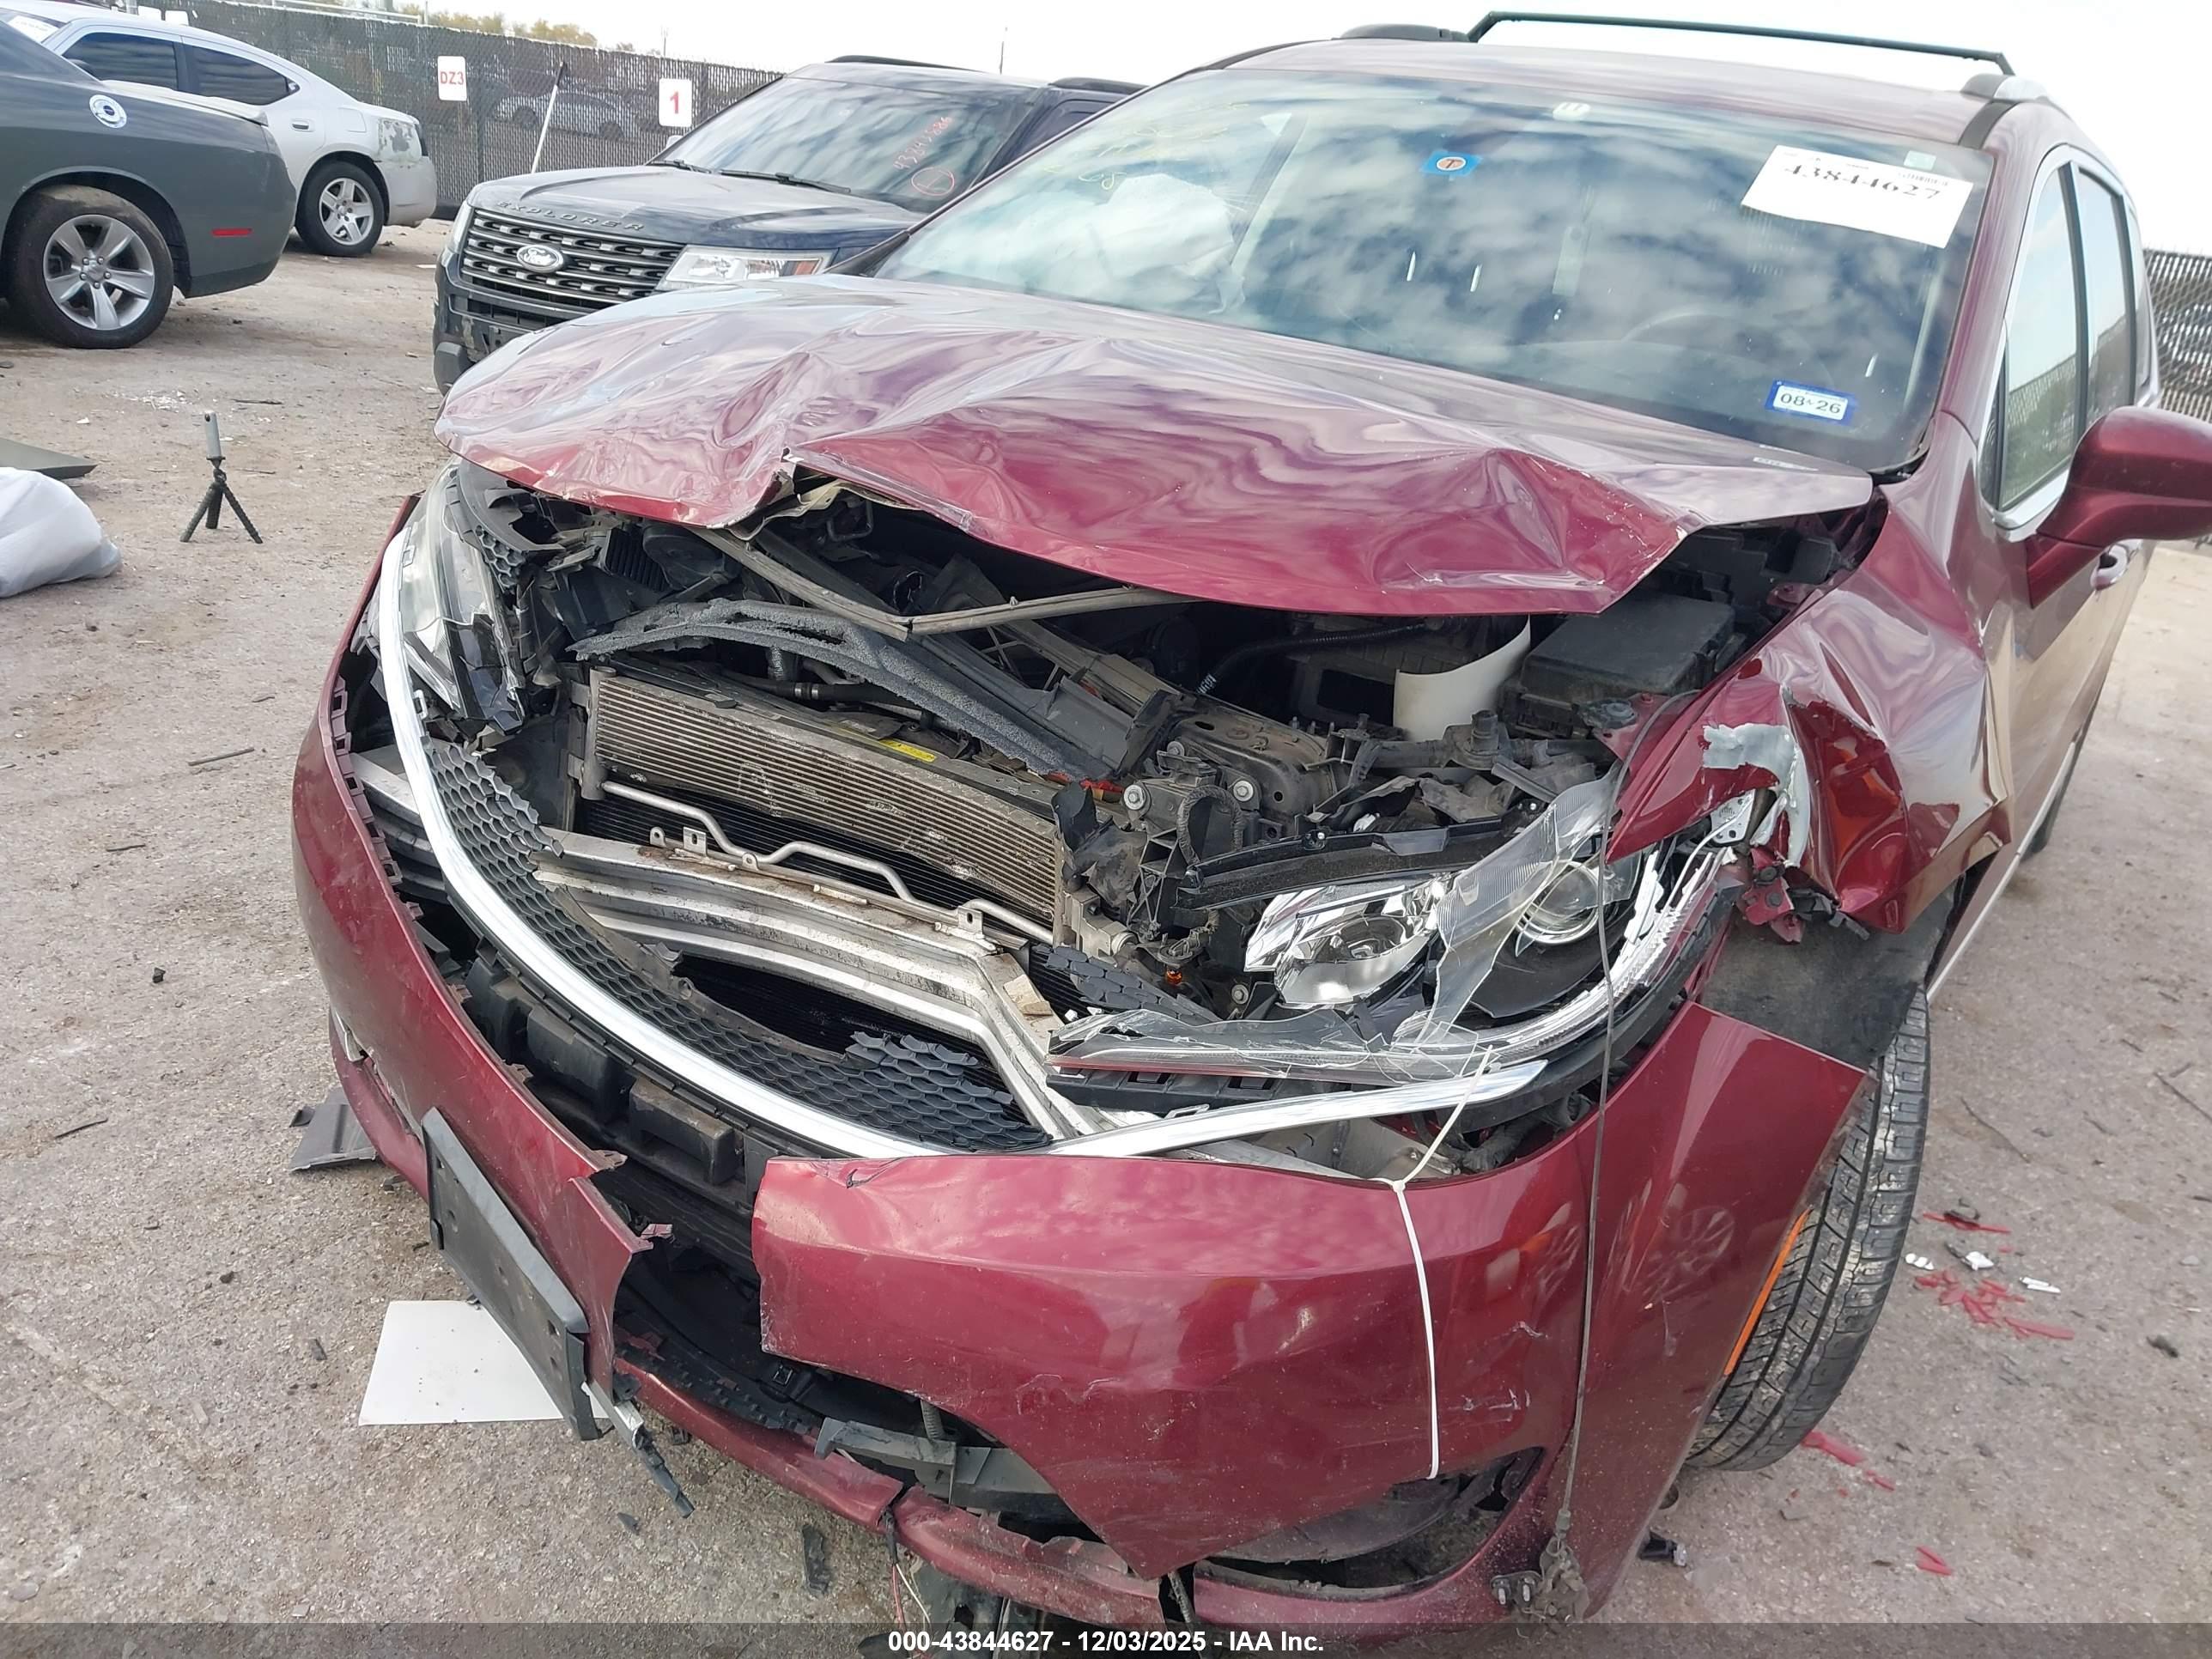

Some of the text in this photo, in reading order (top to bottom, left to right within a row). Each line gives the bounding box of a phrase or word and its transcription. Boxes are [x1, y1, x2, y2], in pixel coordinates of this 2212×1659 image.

[440, 71, 465, 85] DZ3
[669, 91, 680, 114] 1
[1784, 164, 1941, 200] 43844627
[496, 200, 645, 231] EXPLORER
[1780, 392, 1805, 407] 08
[1815, 399, 1842, 414] 26
